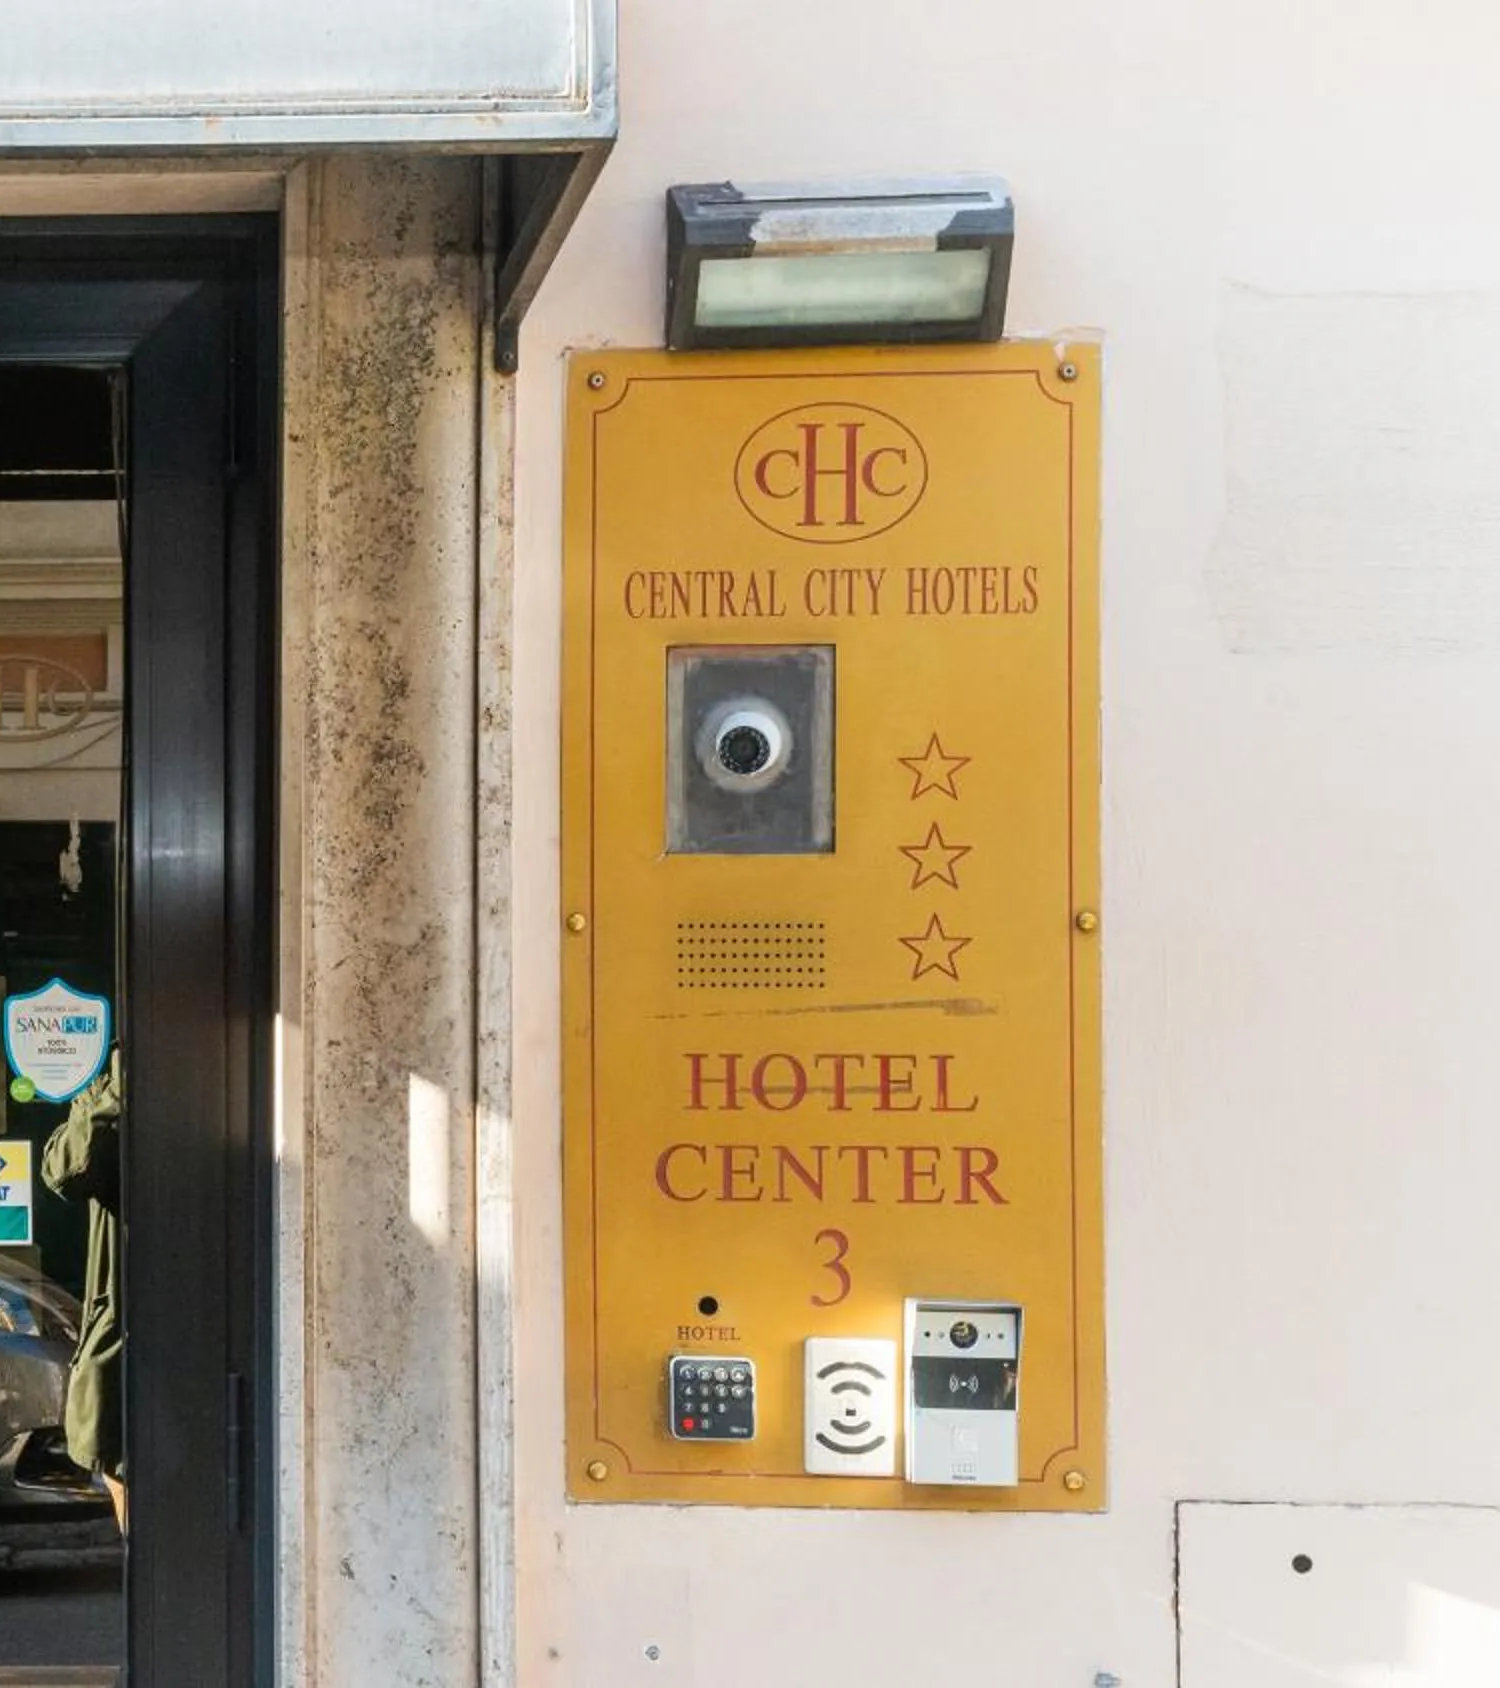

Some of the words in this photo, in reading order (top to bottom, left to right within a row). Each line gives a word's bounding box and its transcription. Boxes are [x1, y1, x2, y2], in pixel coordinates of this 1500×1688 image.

[624, 569, 786, 619] CENTRAL
[803, 567, 887, 617] CITY
[906, 565, 1040, 615] HOTELS
[682, 1053, 980, 1112] HOTEL
[655, 1143, 1011, 1204] CENTER
[809, 1229, 853, 1308] 3
[677, 1325, 741, 1341] HOTEL
